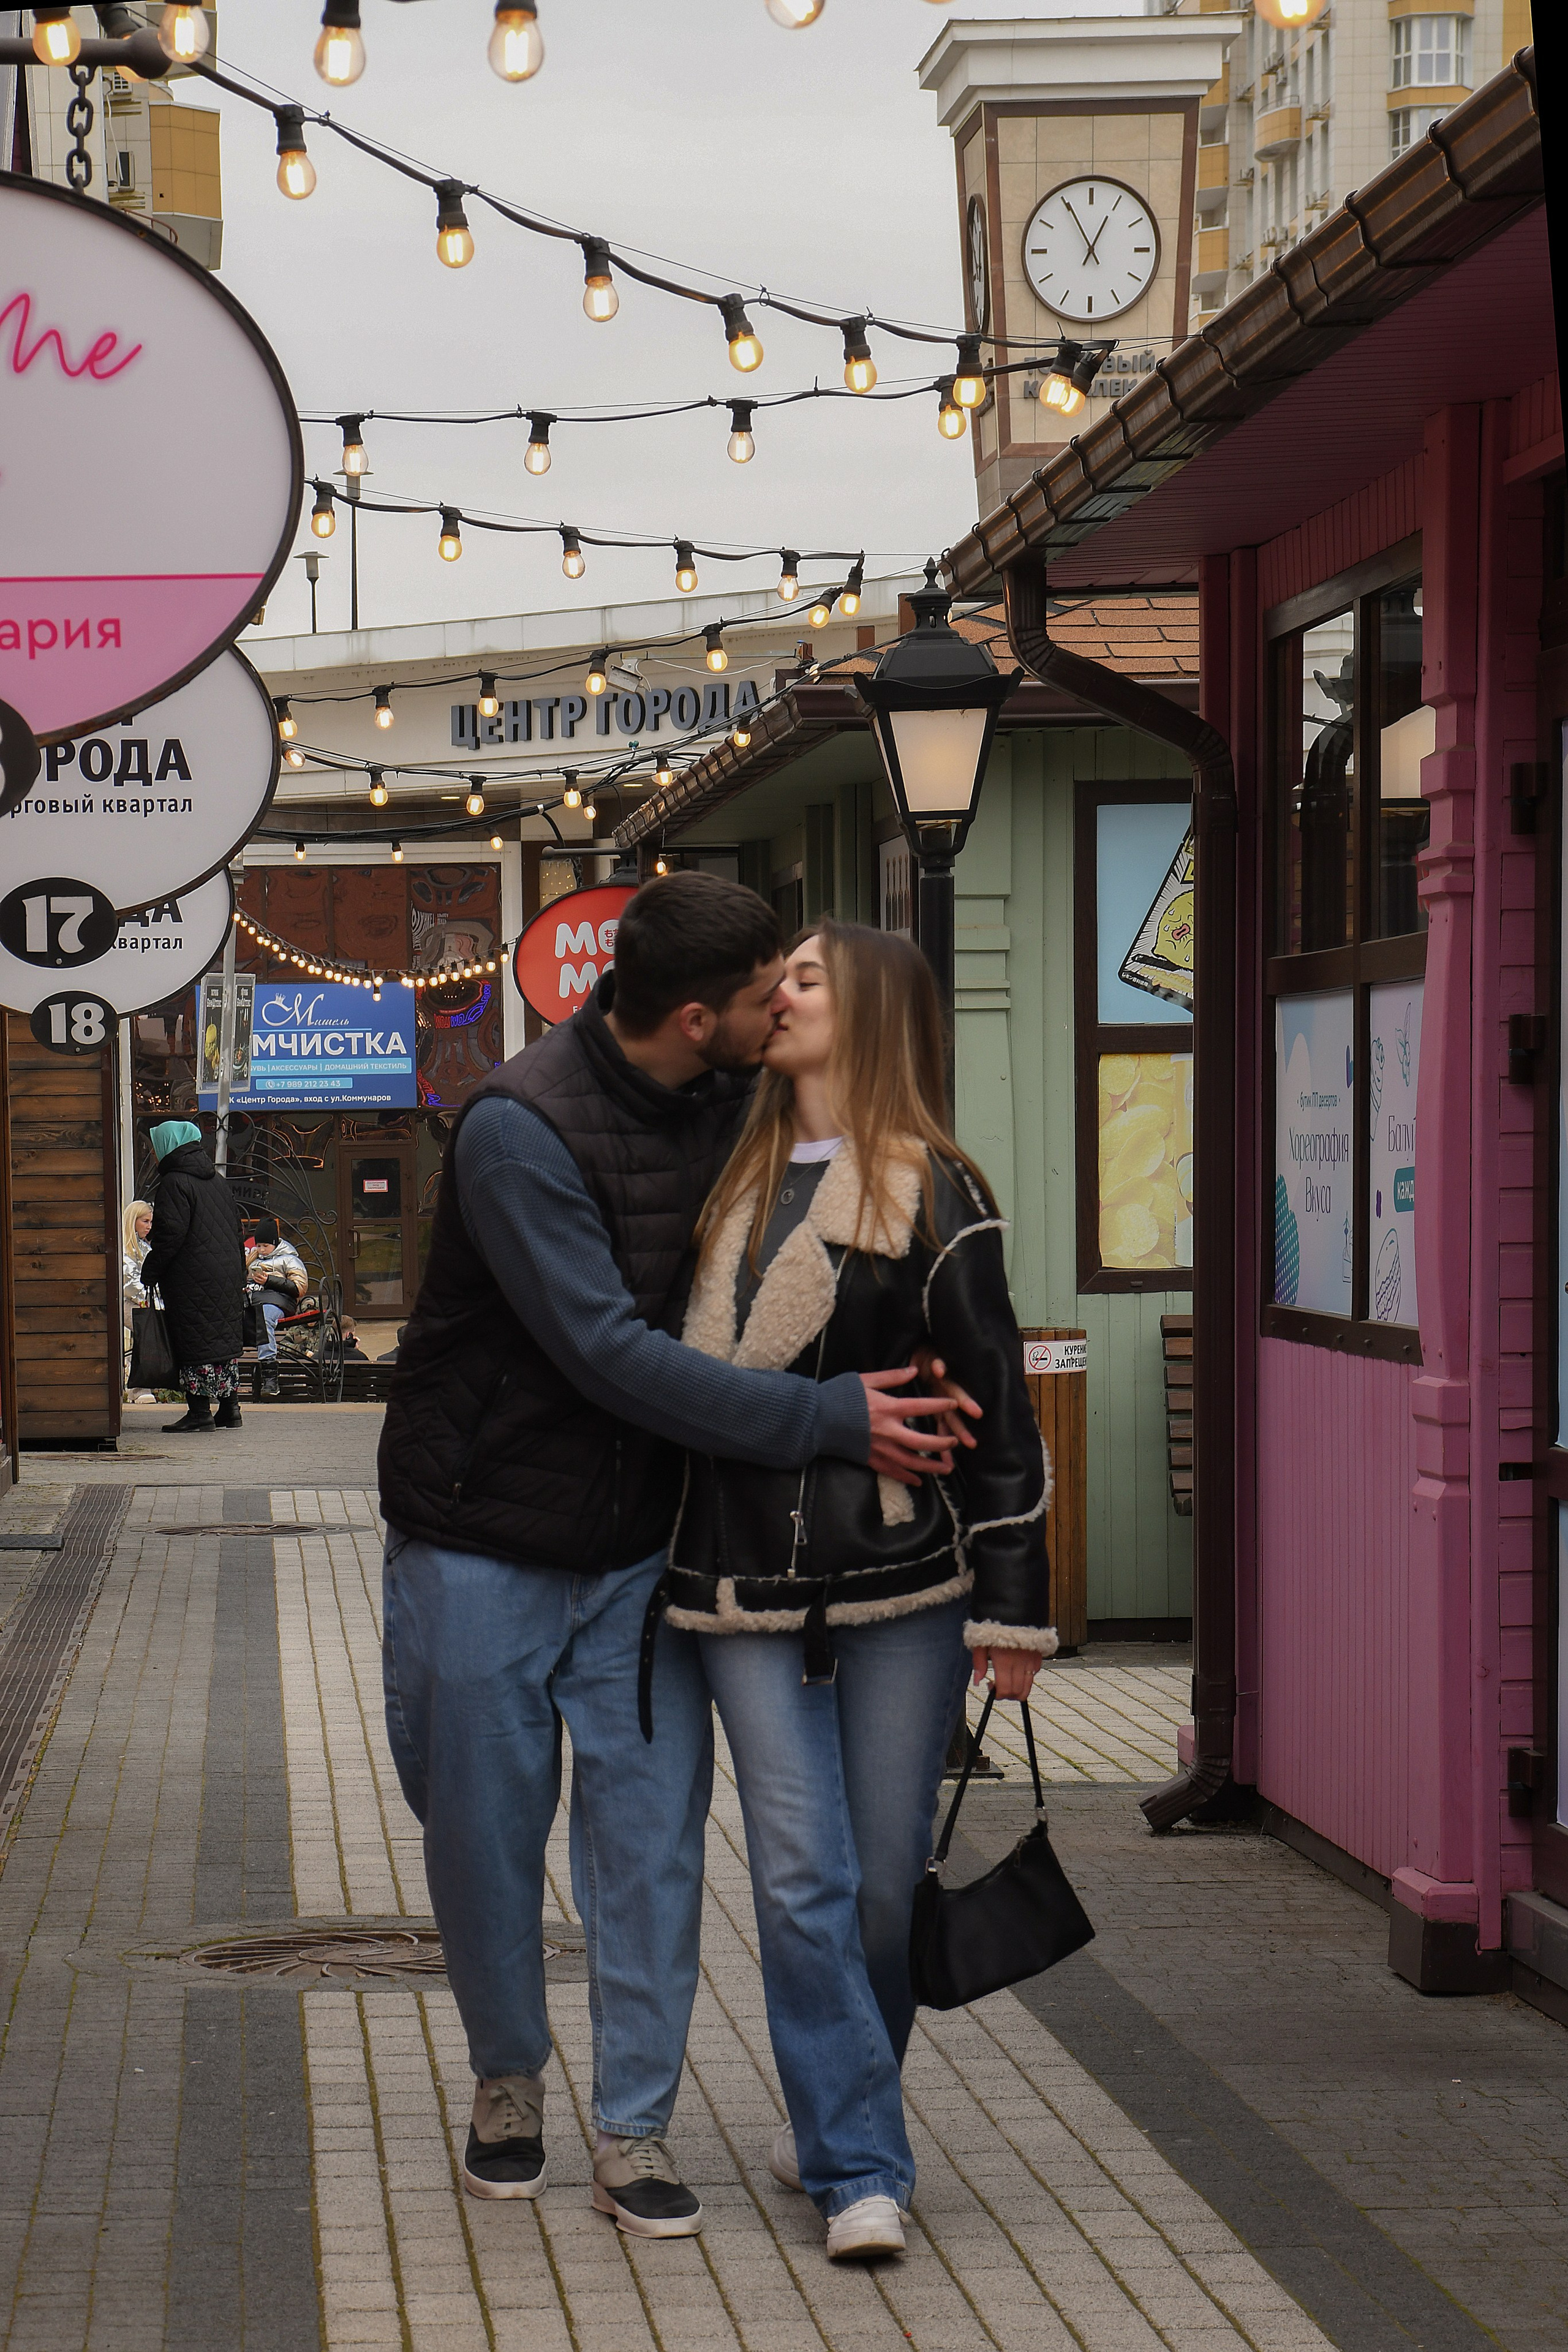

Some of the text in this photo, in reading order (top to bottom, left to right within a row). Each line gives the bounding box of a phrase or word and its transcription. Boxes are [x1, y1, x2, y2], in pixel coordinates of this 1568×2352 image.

[451, 680, 761, 750] ЦЕНТР ГОРОДА
[38, 738, 192, 786] РОДА
[103, 797, 192, 818] квартал
[22, 895, 94, 954] 17
[48, 1003, 105, 1044] 18
[262, 992, 349, 1027] Мишель
[324, 1062, 369, 1071] ДОМАШНИЙ
[268, 1096, 302, 1104] Города»,
[1319, 1094, 1338, 1111] десертов
[1289, 1126, 1349, 1171] Хореография
[1305, 1176, 1331, 1222] Вкуса
